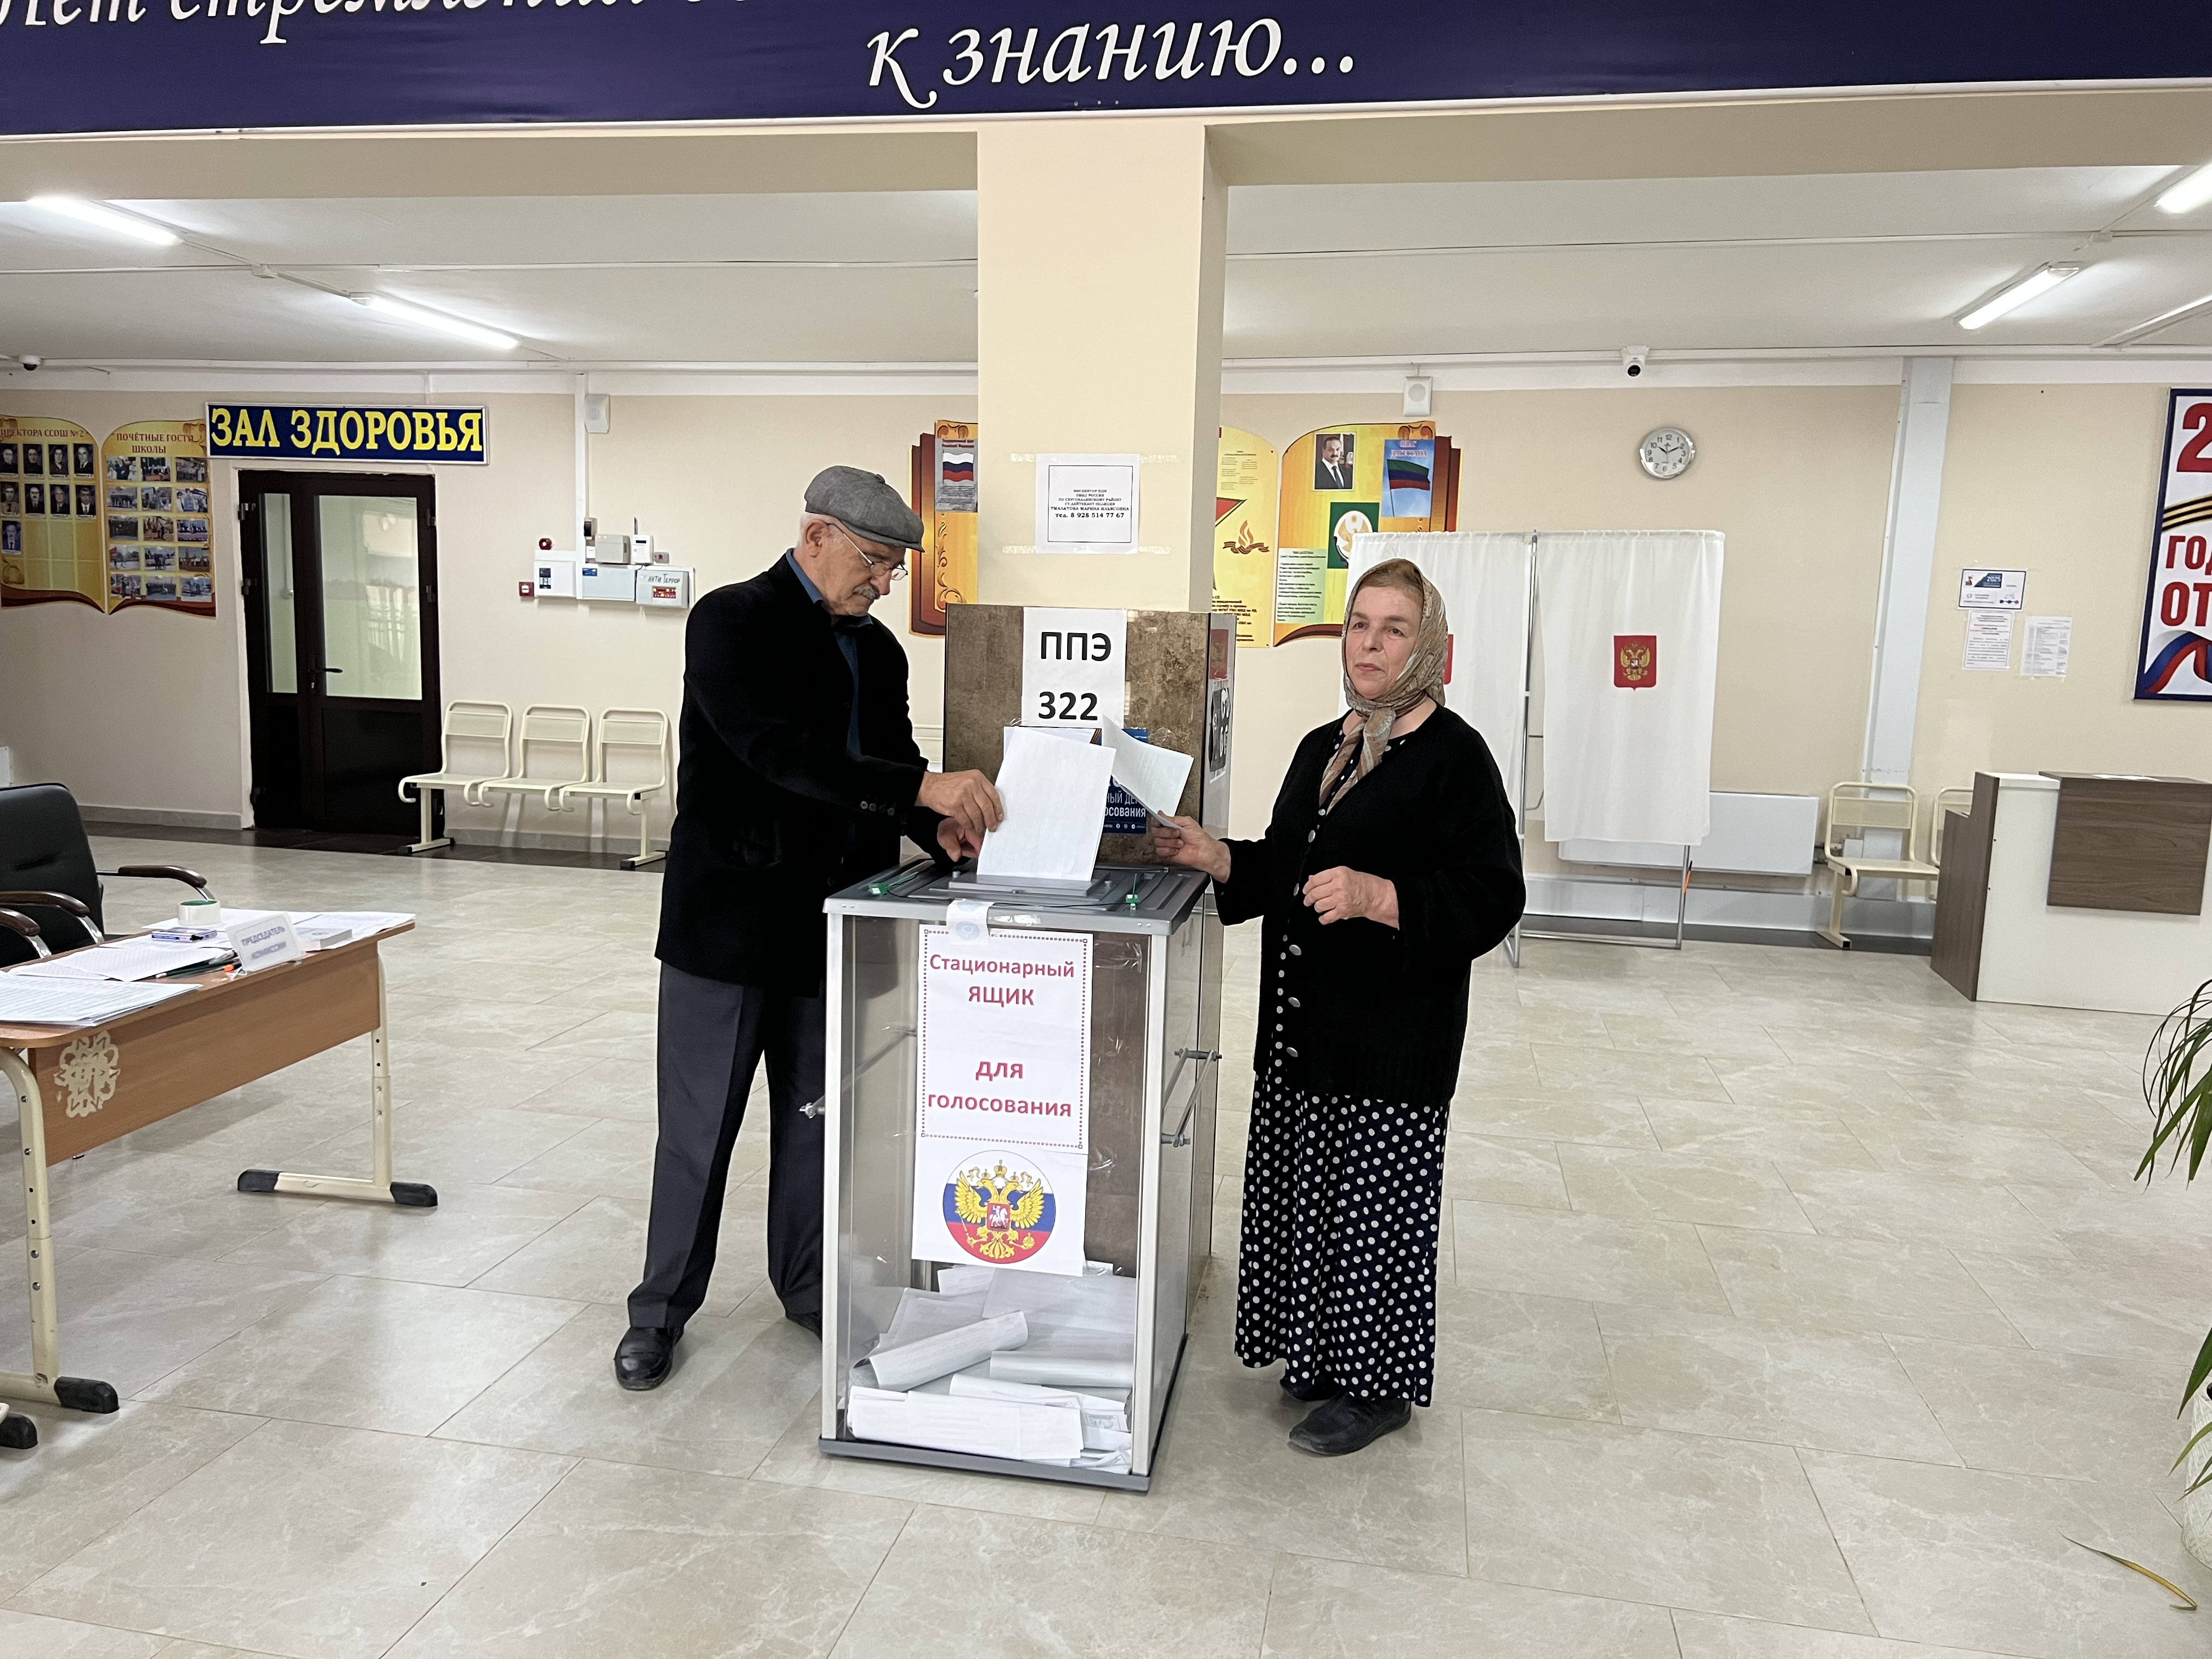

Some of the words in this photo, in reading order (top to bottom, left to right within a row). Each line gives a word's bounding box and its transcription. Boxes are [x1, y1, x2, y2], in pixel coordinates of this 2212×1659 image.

[867, 27, 938, 109] к
[941, 18, 1354, 86] знанию...
[42, 429, 68, 437] ССОШ
[116, 432, 165, 442] ПОЧЁТНЫЕ
[166, 434, 194, 442] ГОСТИ
[211, 408, 280, 447] ЗАЛ
[291, 410, 483, 455] ЗДОРОВЬЯ
[132, 445, 166, 454] ШКОЛЫ
[1041, 631, 1111, 662] ППЭ
[1039, 691, 1098, 721] 322
[241, 926, 285, 946] ПРЕДСЕДАТЕЛЬ
[929, 954, 1074, 978] Стационарный
[928, 1094, 1071, 1117] голосования
